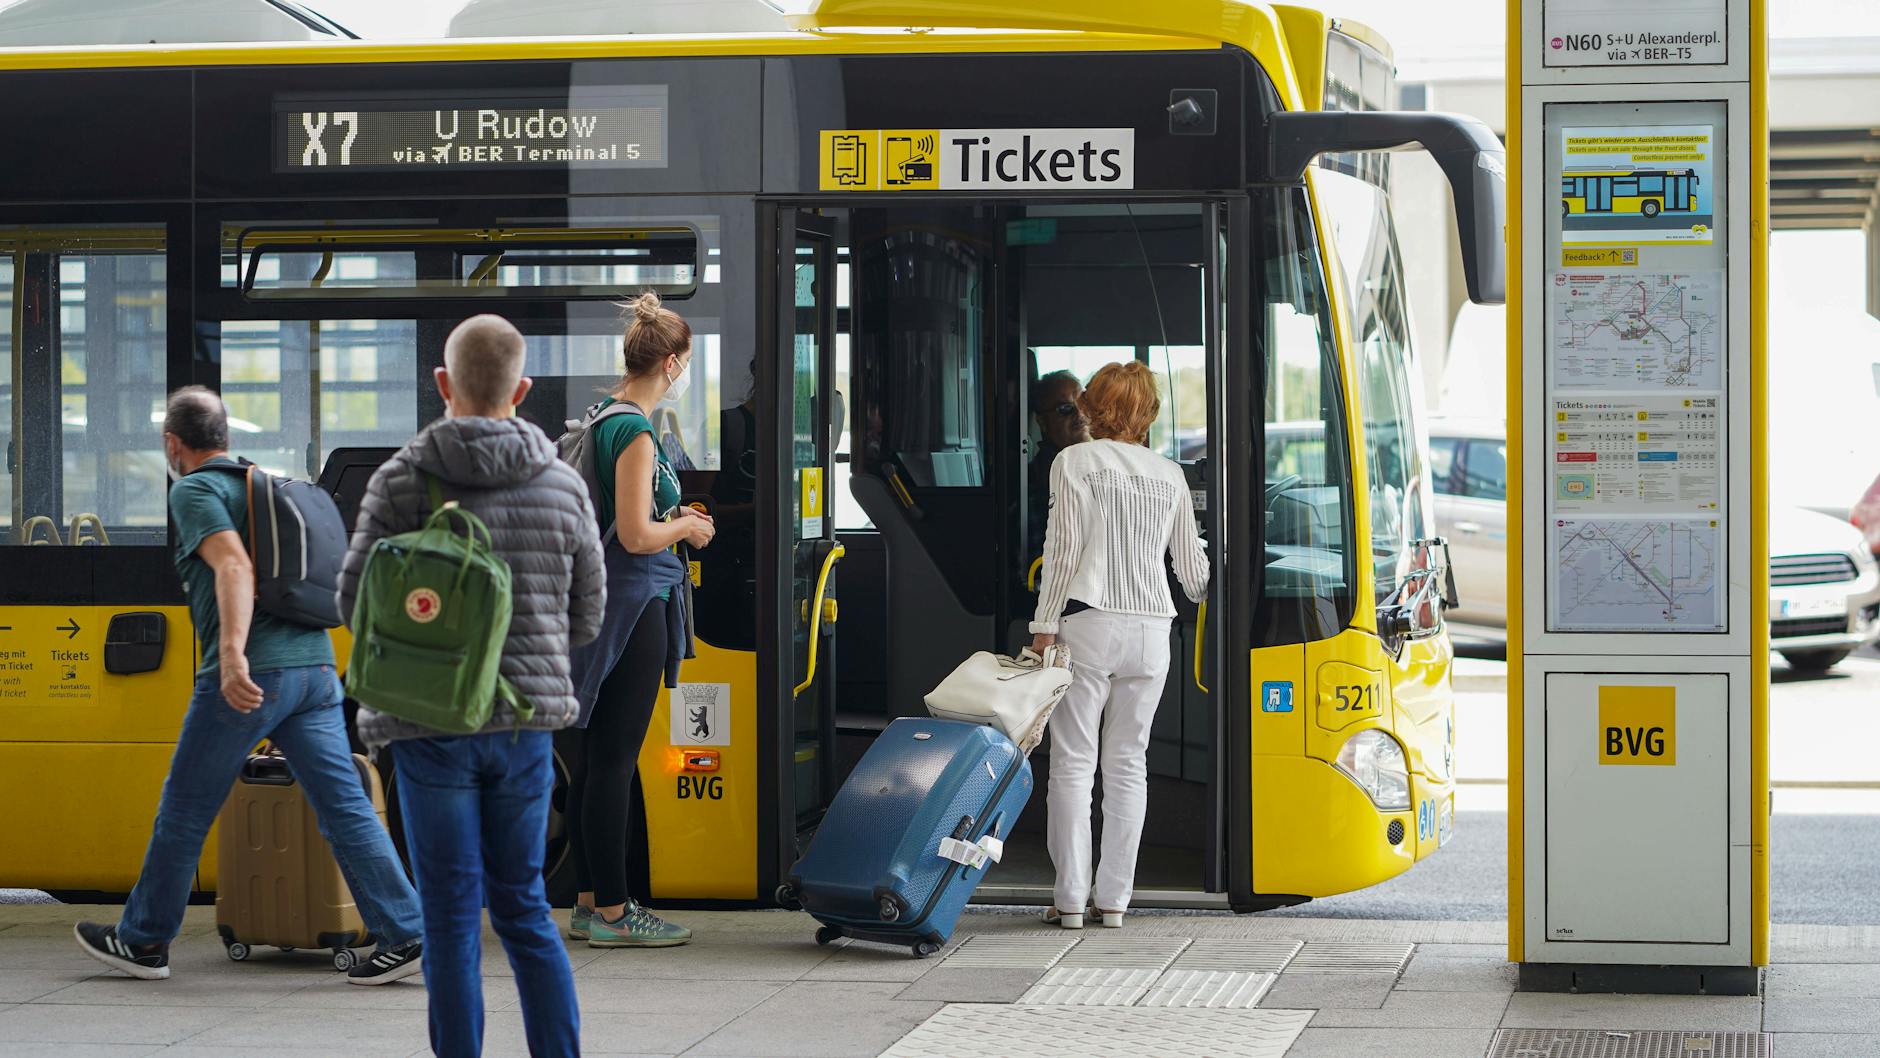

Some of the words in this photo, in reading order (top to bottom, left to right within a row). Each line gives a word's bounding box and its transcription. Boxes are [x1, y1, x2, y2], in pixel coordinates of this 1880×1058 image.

[1566, 34, 1602, 51] N60
[1606, 33, 1634, 46] S+U
[1638, 31, 1721, 46] Alexanderpl.
[1607, 49, 1627, 60] via
[435, 109, 459, 140] U
[477, 108, 597, 140] Rudow
[302, 111, 358, 166] X7
[392, 148, 426, 163] via
[458, 145, 504, 163] BER
[513, 143, 618, 163] Terminal
[626, 143, 641, 160] 5
[952, 135, 1121, 183] Tickets
[1565, 253, 1605, 261] Feedback?
[1556, 401, 1583, 409] Tickets
[12, 650, 26, 658] mit
[51, 650, 89, 661] Tickets
[9, 661, 33, 670] Ticket
[4, 689, 26, 697] ticket
[1335, 684, 1380, 712] 5211
[1605, 726, 1665, 757] BVG
[677, 775, 723, 800] BVG
